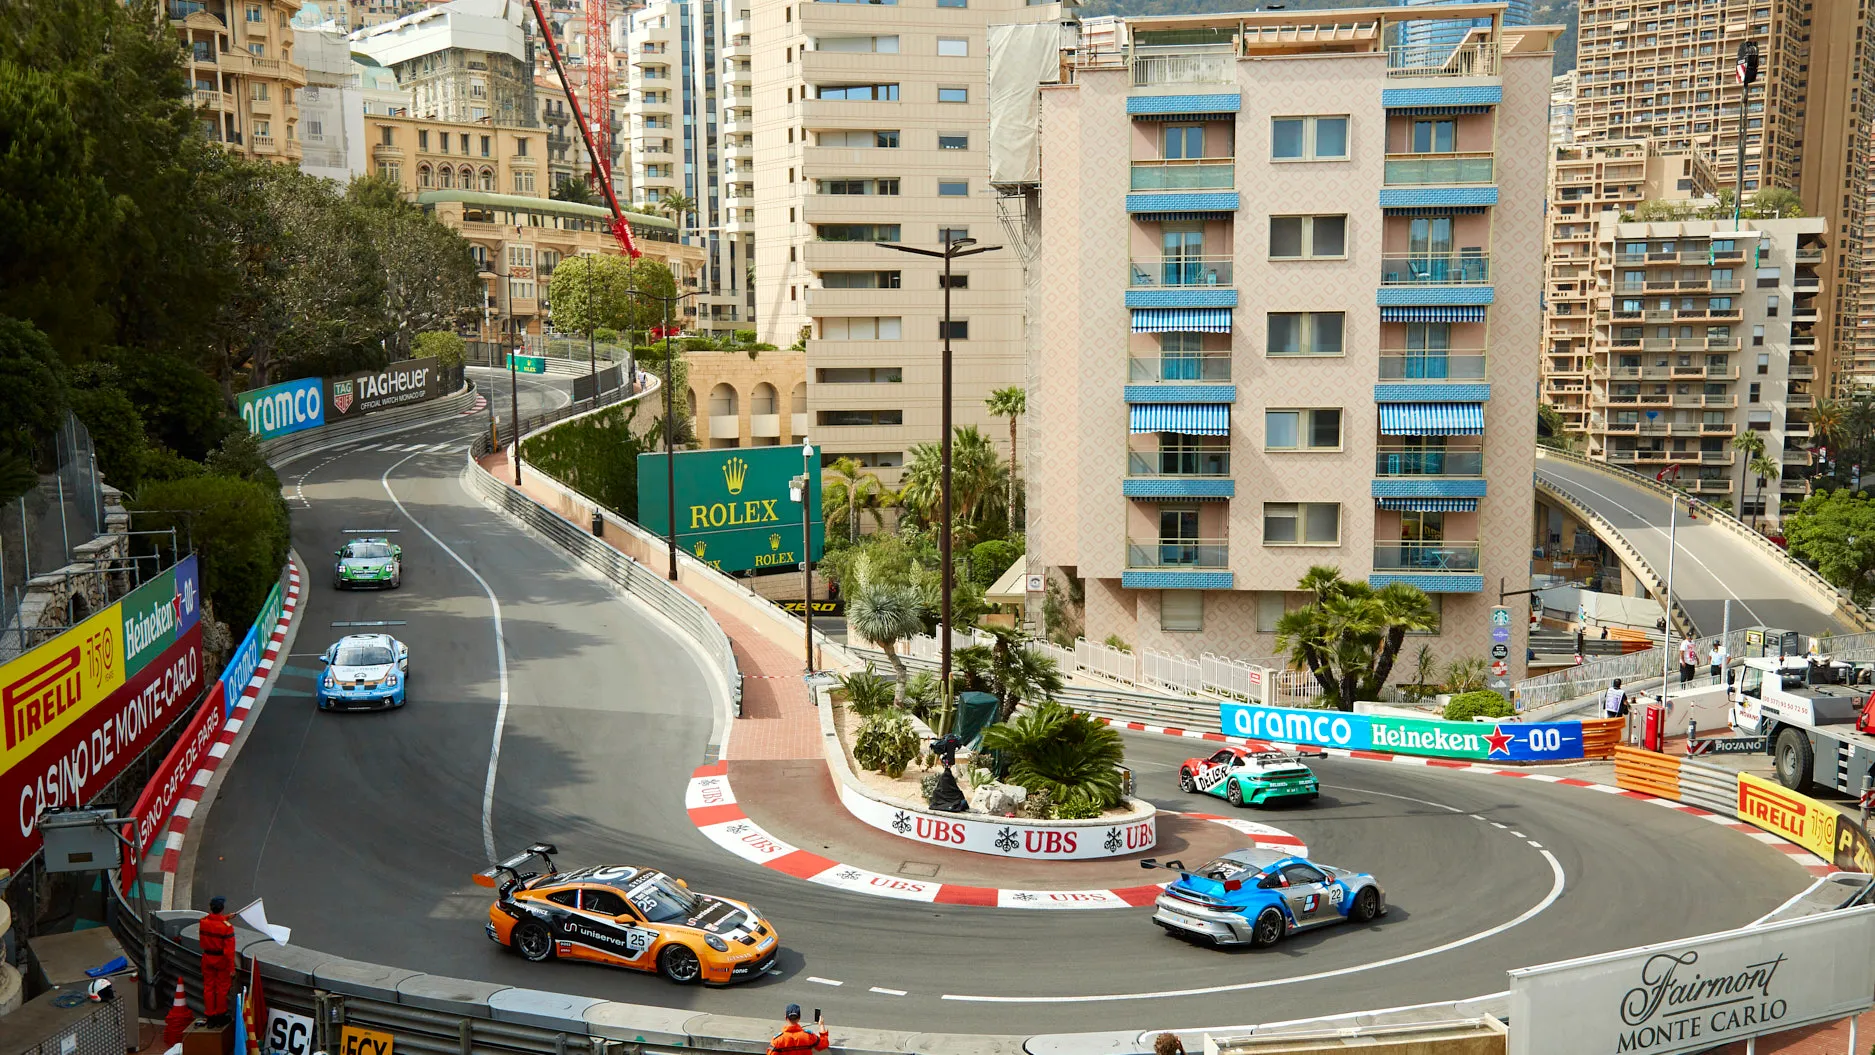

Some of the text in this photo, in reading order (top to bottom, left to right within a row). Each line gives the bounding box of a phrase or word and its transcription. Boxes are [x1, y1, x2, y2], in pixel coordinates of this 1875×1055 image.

[335, 382, 352, 394] TAG
[334, 394, 353, 413] HEUER
[361, 400, 381, 410] OFFICIAL
[382, 395, 398, 406] WATCH
[398, 391, 419, 402] MONACO
[243, 387, 320, 437] aramco
[690, 499, 779, 529] ROLEX
[755, 552, 794, 567] ROLEX
[125, 600, 174, 661] Heineken
[228, 638, 257, 707] aramco
[2, 645, 81, 752] PIRELLI
[1235, 709, 1351, 744] aramco
[1740, 710, 1759, 722] PIOVANO
[20, 646, 197, 838] CASINO DE MONTE-CARLO
[1372, 724, 1480, 751] Heineken
[1716, 741, 1762, 751] PIOVANO
[163, 759, 186, 807] CAFE
[186, 739, 198, 771] DE
[198, 706, 219, 753] PARIS
[701, 786, 724, 804] UBS
[1739, 780, 1806, 837] PIRELLI
[742, 833, 782, 853] UBS
[916, 816, 1154, 853] UBS UBS UBS
[1839, 829, 1853, 851] P
[870, 877, 926, 893] UBS
[1331, 889, 1341, 900] 22
[638, 896, 658, 913] 25
[1049, 893, 1107, 902] UBS
[580, 928, 626, 947] uniserver
[630, 934, 645, 946] 25
[1620, 951, 1788, 1026] Fairmont
[270, 1017, 307, 1055] SC
[1616, 999, 1787, 1054] MONTE CARLO
